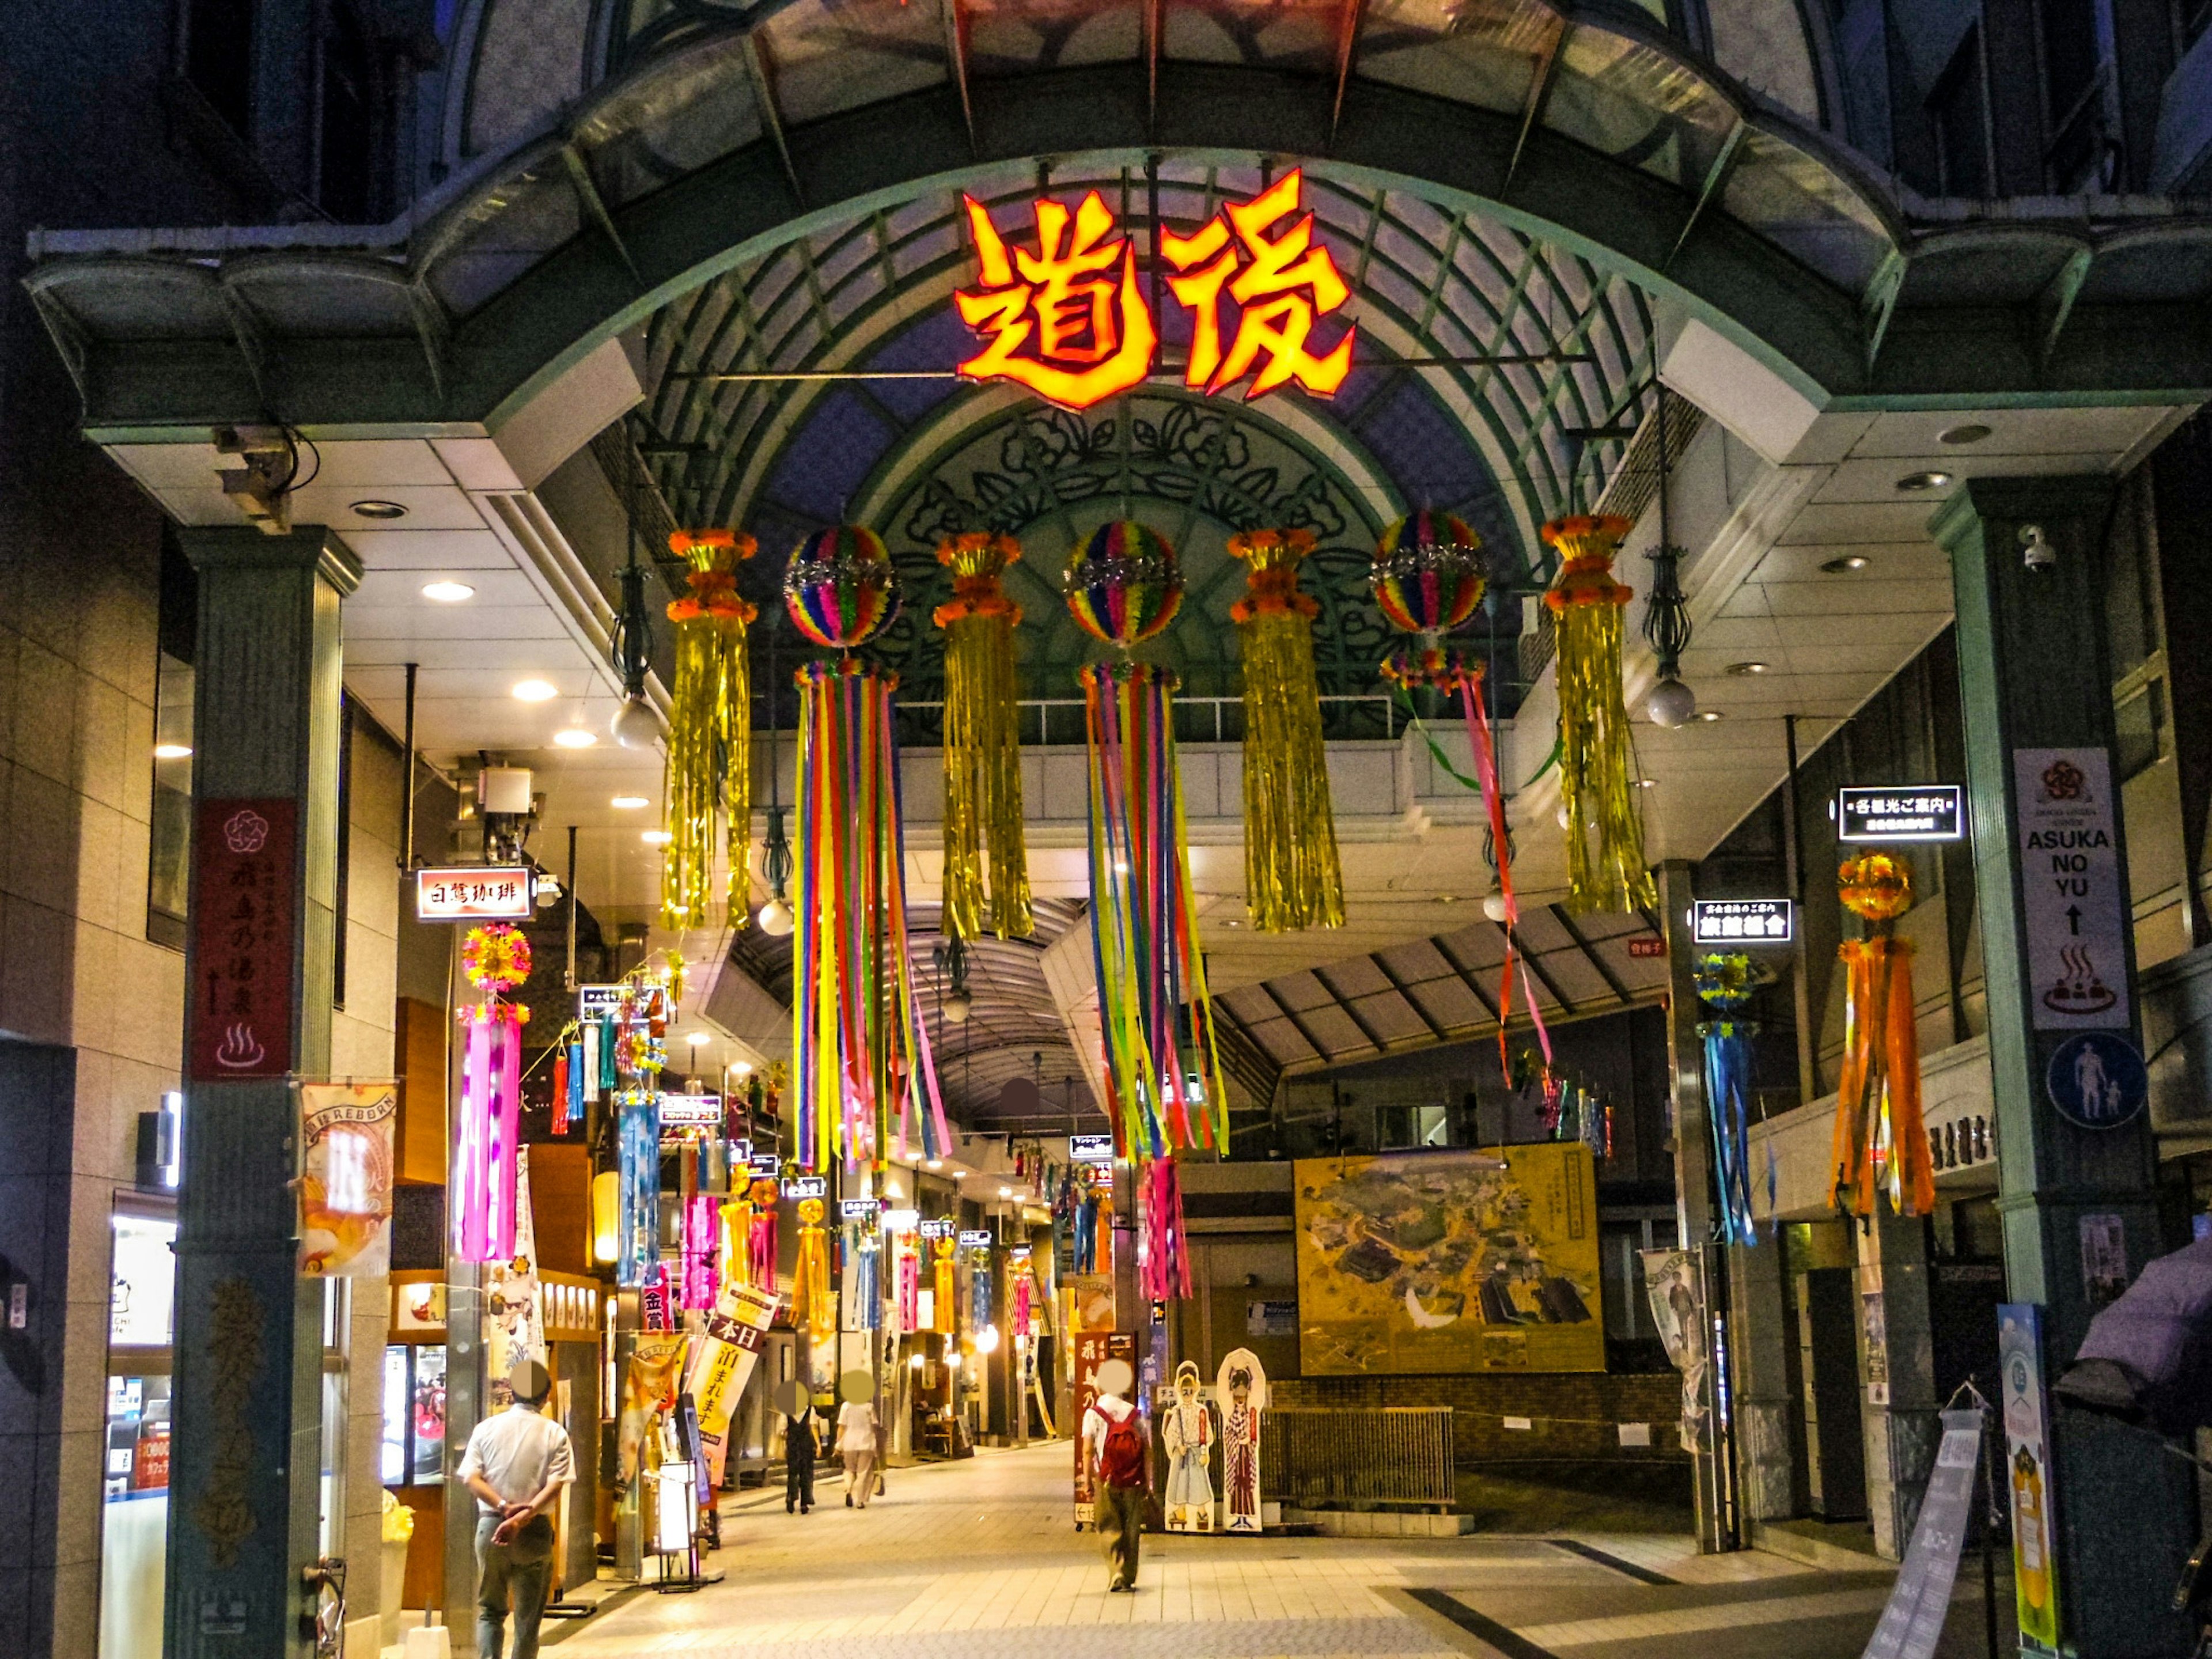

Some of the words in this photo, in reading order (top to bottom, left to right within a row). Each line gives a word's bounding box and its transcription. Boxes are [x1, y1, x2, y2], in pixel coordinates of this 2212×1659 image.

[954, 166, 1358, 410] 道後
[2027, 830, 2109, 849] ASUKA
[2052, 854, 2088, 873] NO
[430, 882, 517, 904] 白鷺珈琲
[2055, 878, 2088, 897] YU
[334, 1096, 394, 1120] REBORN
[718, 1319, 758, 1349] 本日
[698, 1346, 739, 1426] 泊まれます
